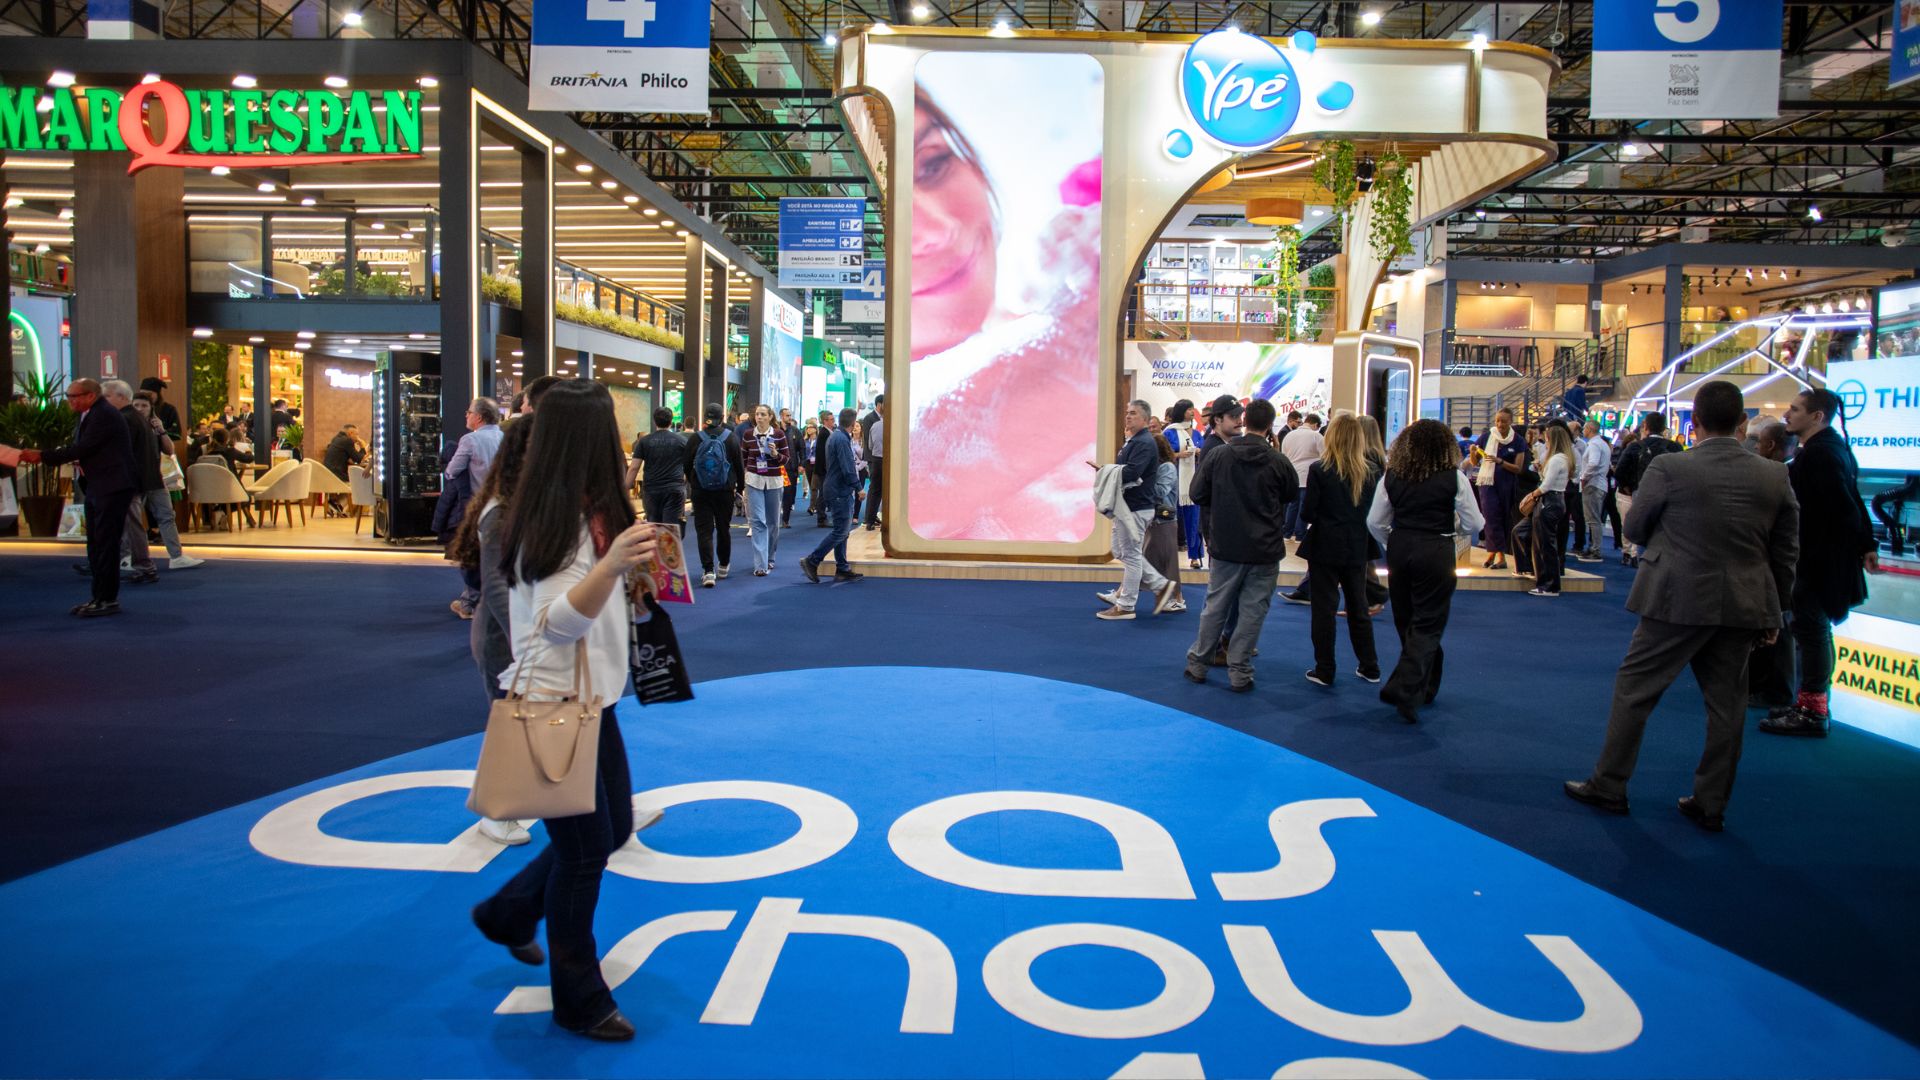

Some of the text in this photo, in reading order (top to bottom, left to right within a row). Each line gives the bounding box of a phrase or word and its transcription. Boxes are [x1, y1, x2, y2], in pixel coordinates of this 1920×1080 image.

[640, 73, 688, 89] Philco
[1192, 59, 1290, 121] Ypê
[1668, 87, 1700, 96] Nestlé
[0, 80, 424, 175] MARQUESPAN
[861, 269, 885, 299] 4
[1152, 360, 1225, 370] NOVO TIXAN
[1152, 372, 1205, 380] POWER ACT
[493, 897, 1644, 1053] show
